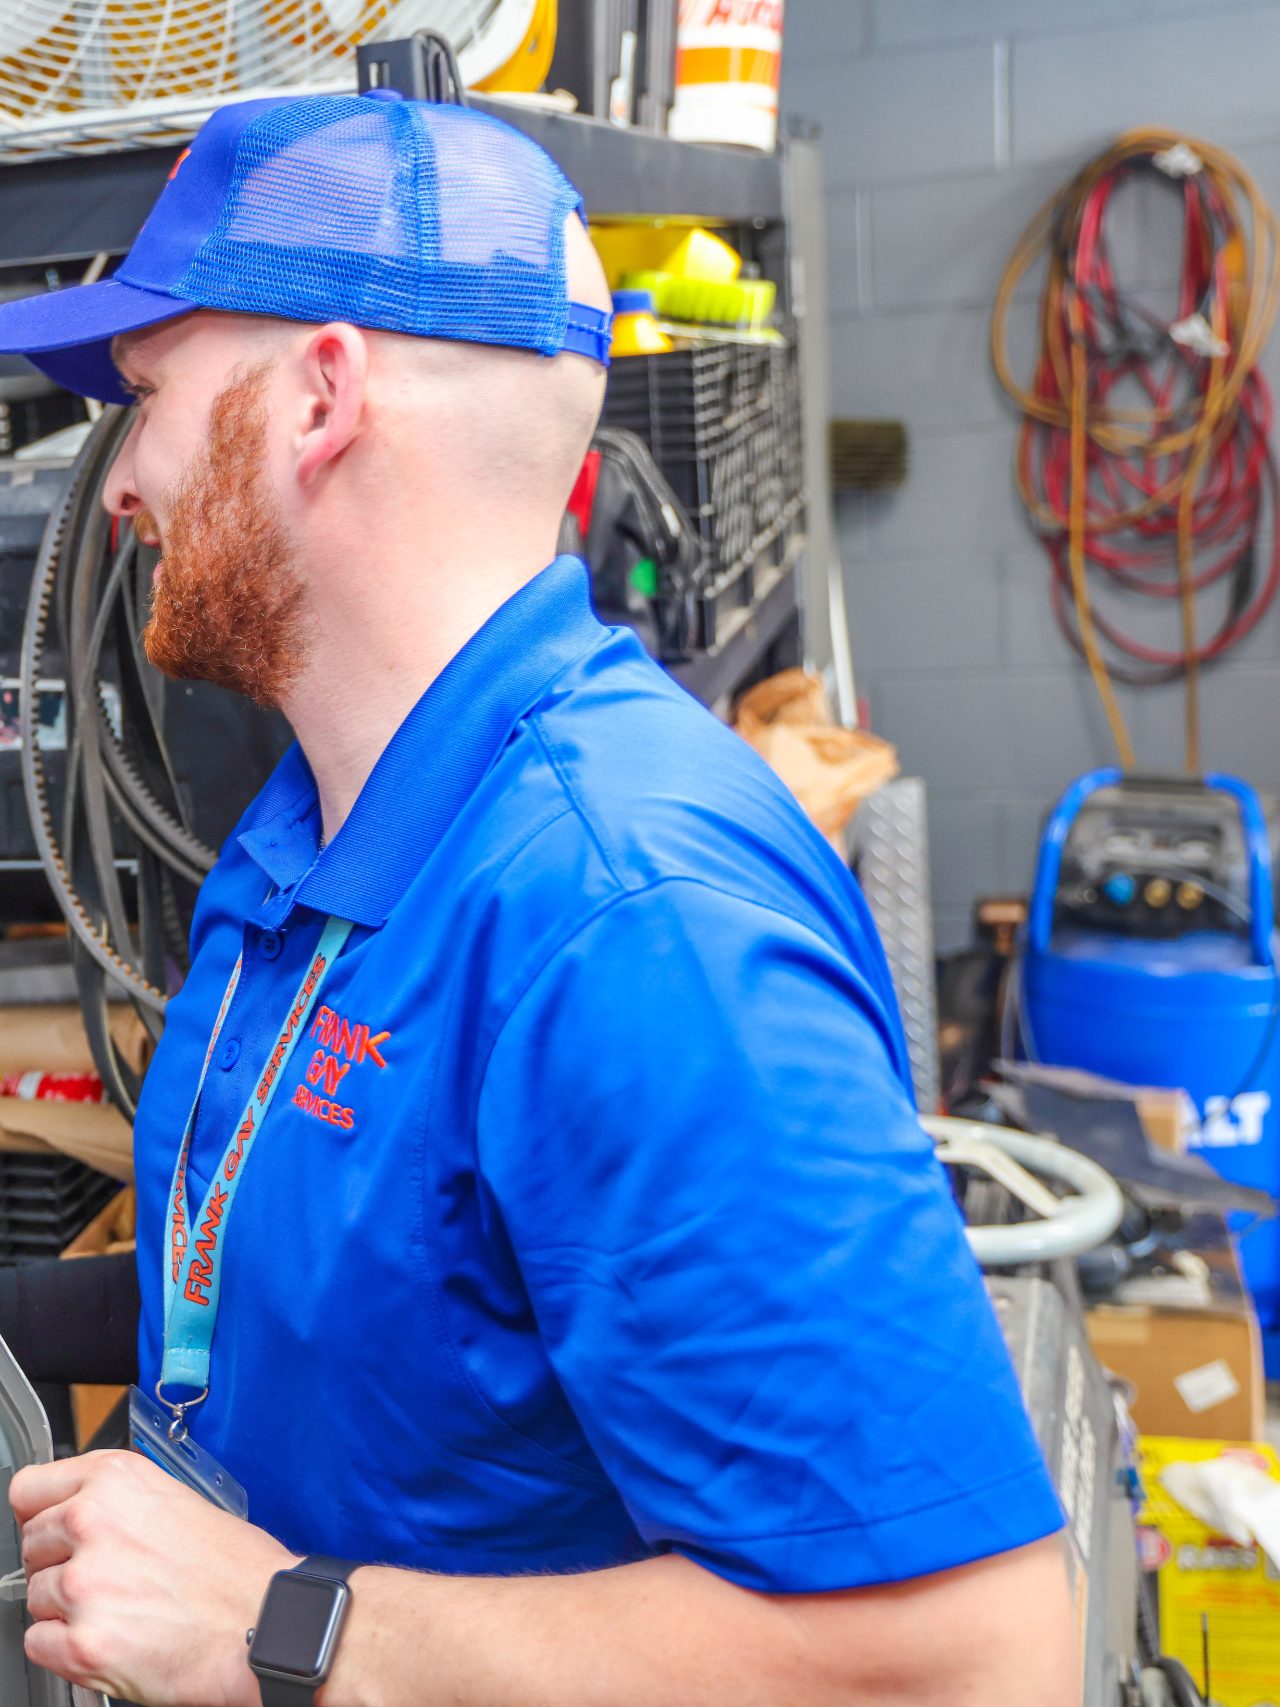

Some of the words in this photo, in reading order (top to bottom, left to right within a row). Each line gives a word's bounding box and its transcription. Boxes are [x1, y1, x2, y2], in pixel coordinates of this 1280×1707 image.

[183, 1182, 228, 1306] FRANK
[224, 1105, 256, 1181] GAY
[257, 952, 327, 1106] SERVICES
[306, 1049, 351, 1096] GAY
